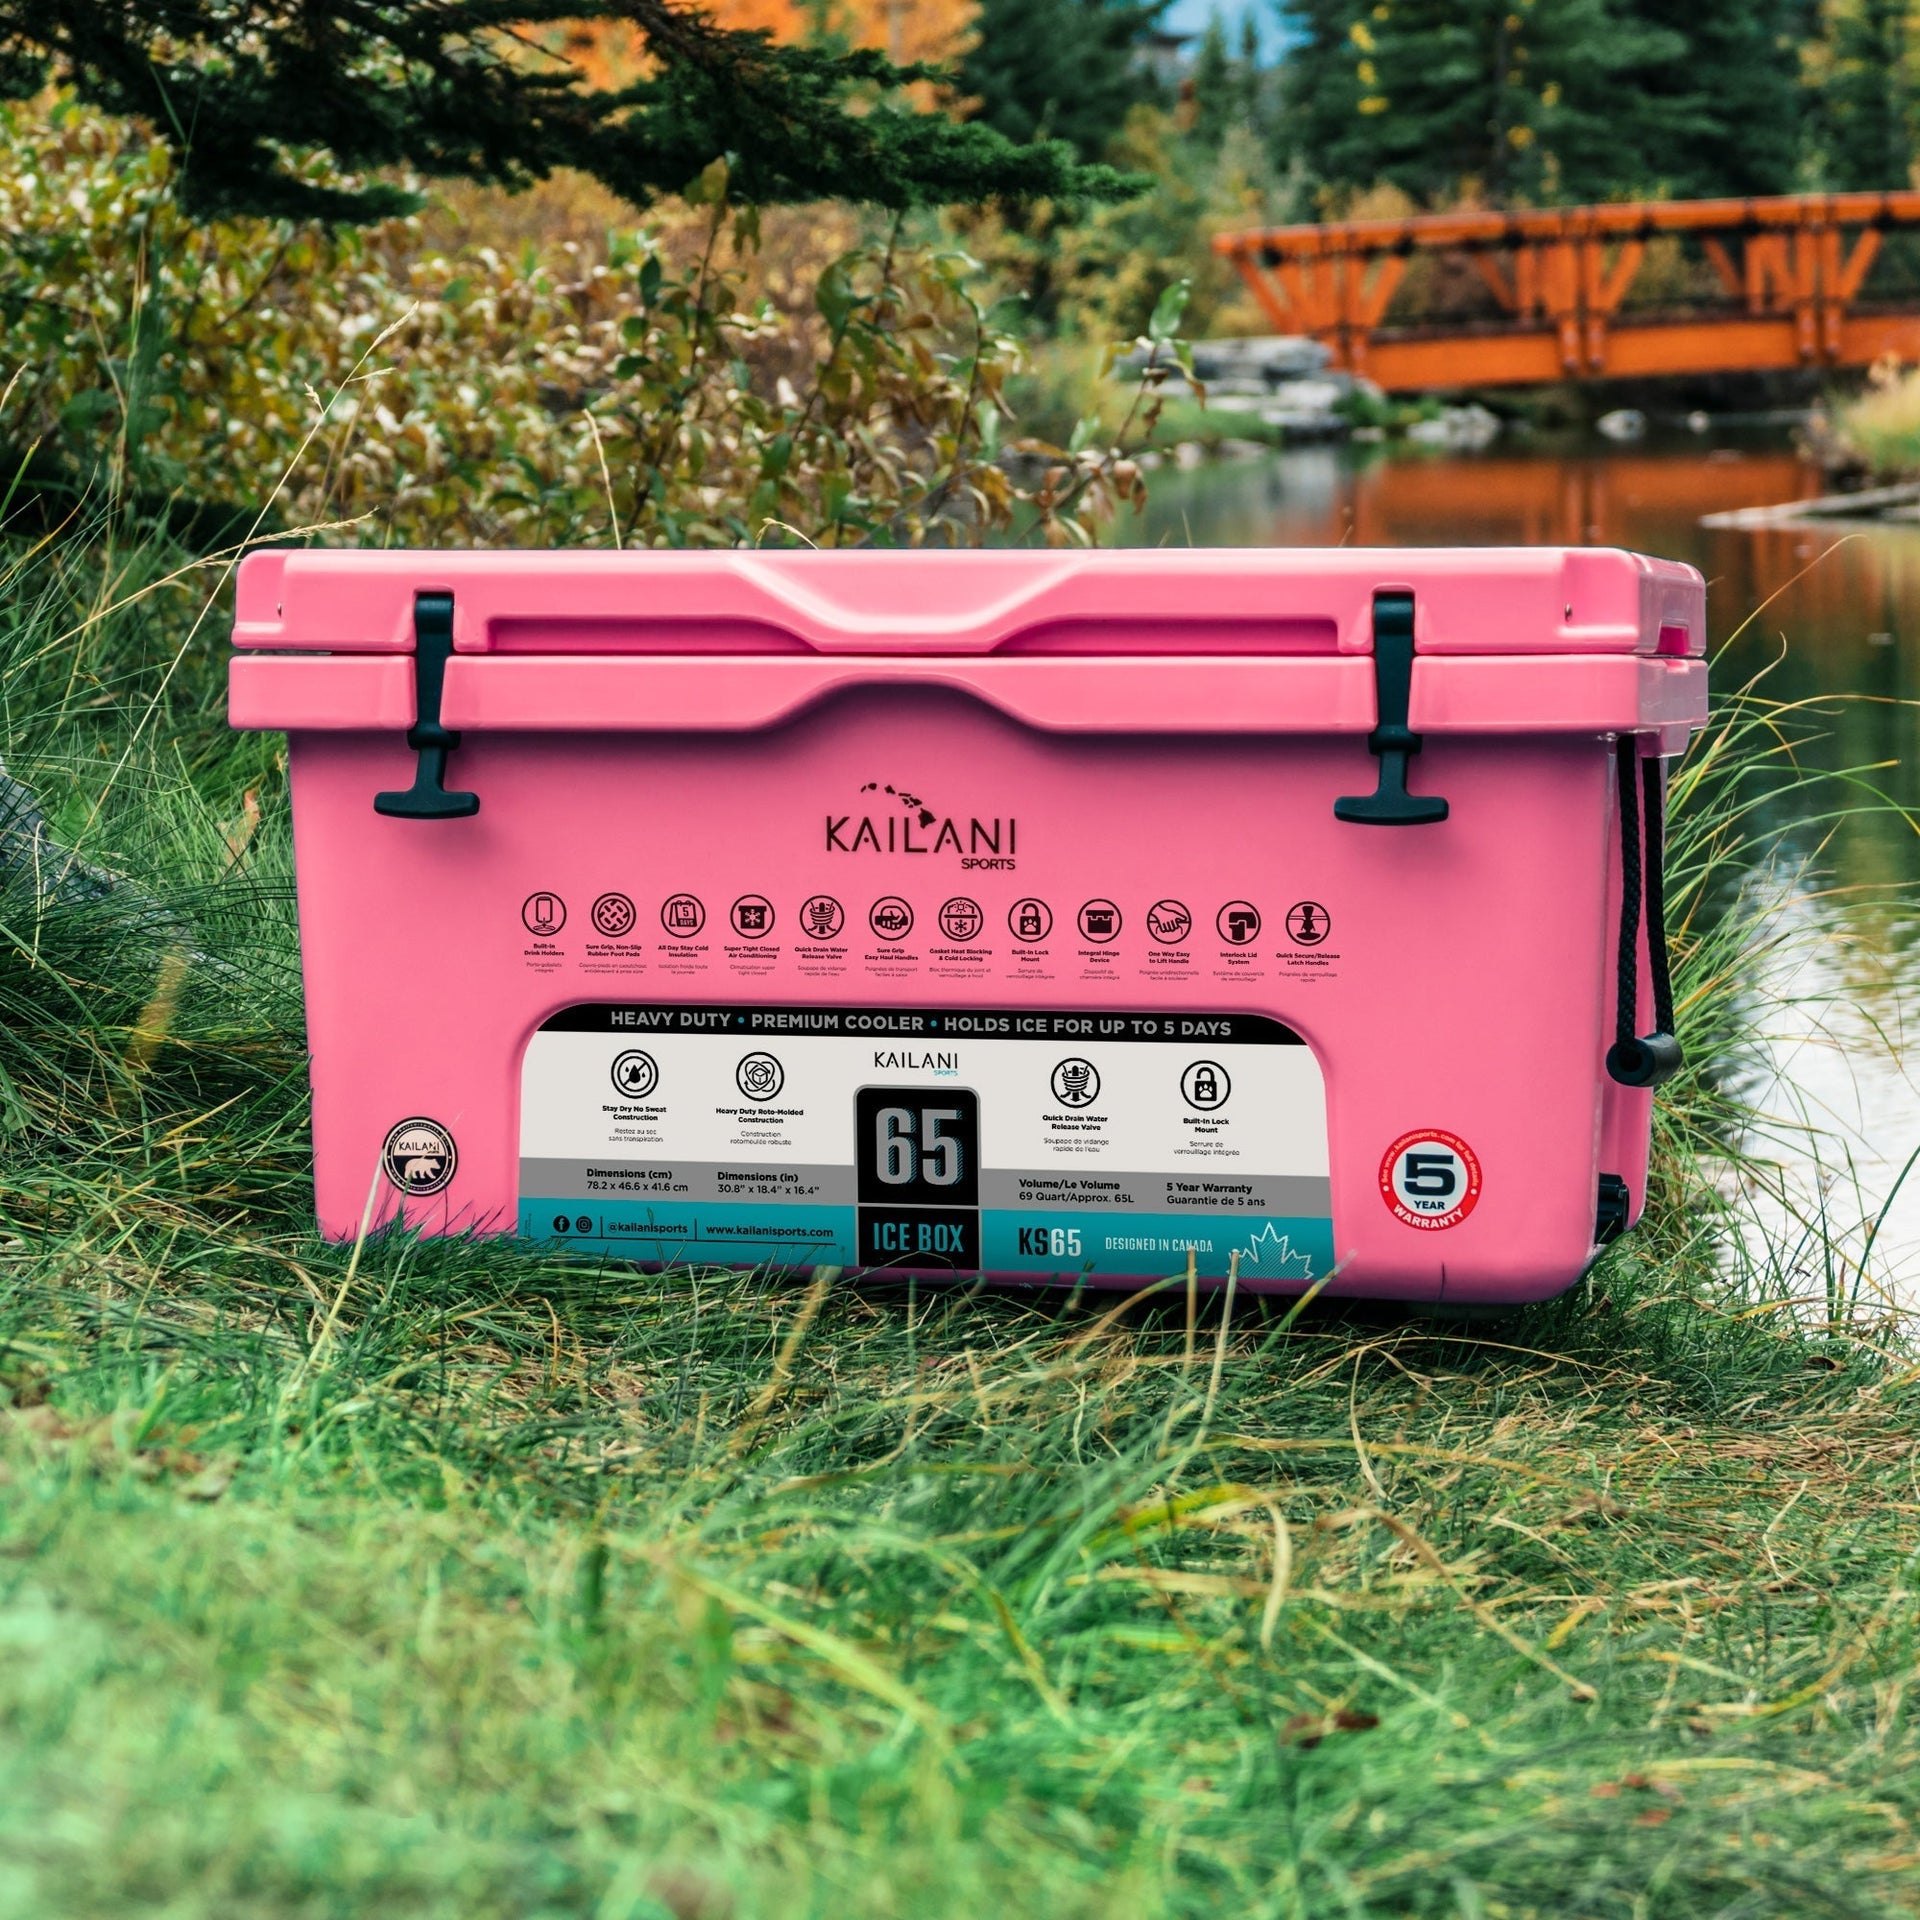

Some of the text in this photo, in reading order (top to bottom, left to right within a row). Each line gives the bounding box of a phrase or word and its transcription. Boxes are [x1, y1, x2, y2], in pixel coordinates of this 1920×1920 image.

[826, 815, 1016, 855] KAILANI
[961, 858, 1016, 870] SPORTS
[682, 906, 689, 917] 5
[611, 1011, 1232, 1036] HEAVY DUTY PREMIUM COOLER HOLDS ICE FOR UP TO 5 DAYS
[874, 1051, 958, 1069] KAILANI
[738, 1116, 784, 1124] Construction
[740, 1130, 781, 1138] Construction
[399, 1141, 440, 1151] KAILANI
[875, 1107, 964, 1186] 65
[586, 1168, 673, 1180] Dimensions (cm)
[717, 1171, 799, 1183] Dimensions (in)
[1404, 1153, 1455, 1196] 5
[587, 1180, 608, 1190] 78.2
[618, 1181, 640, 1191] 46.6
[651, 1182, 671, 1191] 41.6
[673, 1184, 689, 1192] cm
[1019, 1178, 1120, 1191] Volume/Le Volume
[1166, 1182, 1252, 1194] 5 Year Warranty
[1019, 1191, 1134, 1204] 69 Quart/Approx. 65L
[1166, 1195, 1266, 1206] Guarantie de 5 ans
[1414, 1200, 1445, 1210] YEAR
[1393, 1204, 1463, 1229] WARRANTY
[608, 1222, 834, 1238] @kailanisports www.kailanisports.com
[873, 1222, 964, 1253] ICE BOX
[1018, 1228, 1081, 1257] KS65
[1105, 1236, 1214, 1252] DESIGNED IN CANADA
